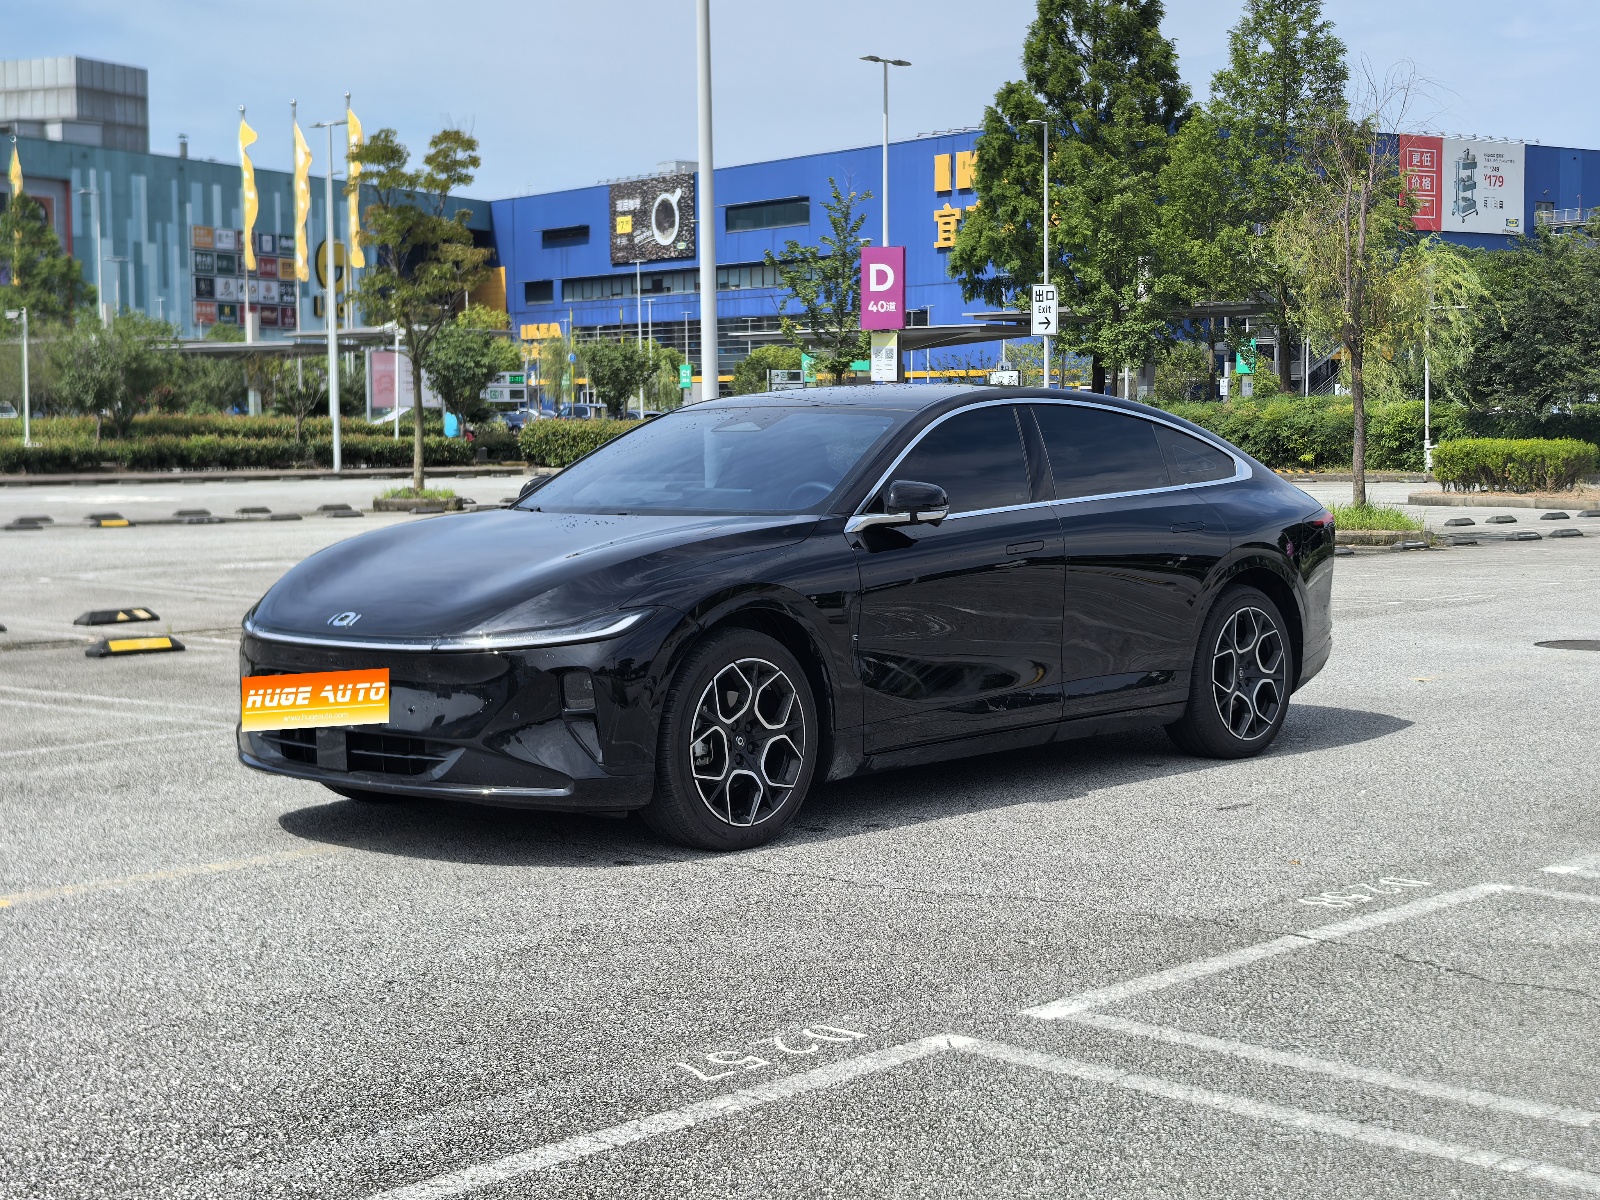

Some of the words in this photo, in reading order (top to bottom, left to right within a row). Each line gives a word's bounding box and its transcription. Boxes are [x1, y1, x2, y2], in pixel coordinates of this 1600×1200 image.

[1411, 152, 1431, 166] 更低
[934, 150, 980, 192] IK
[1411, 176, 1431, 190] 价格
[869, 263, 895, 292] D
[1035, 289, 1055, 303] 出口
[867, 300, 897, 313] 40道
[1038, 305, 1052, 314] Exit
[520, 322, 562, 340] IKEA
